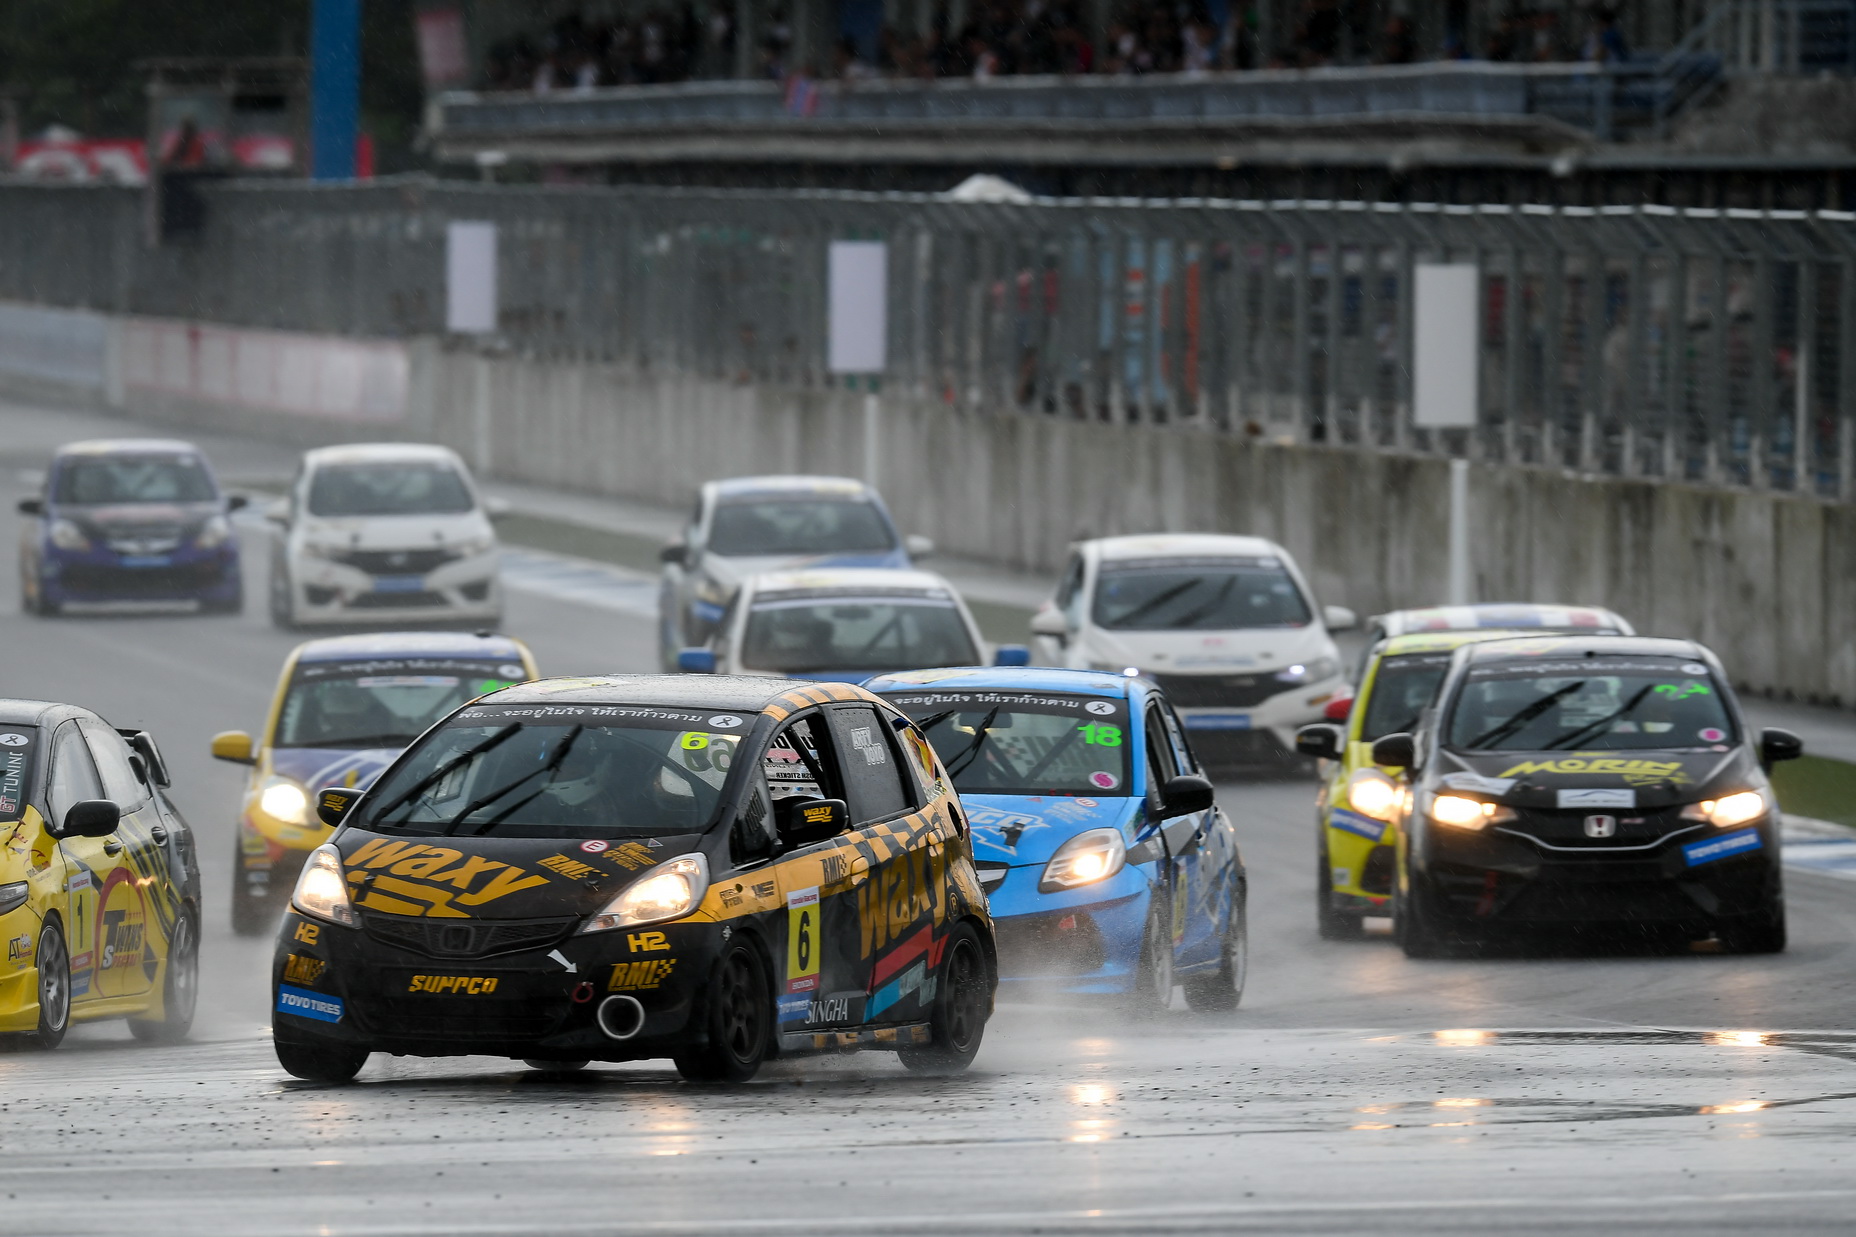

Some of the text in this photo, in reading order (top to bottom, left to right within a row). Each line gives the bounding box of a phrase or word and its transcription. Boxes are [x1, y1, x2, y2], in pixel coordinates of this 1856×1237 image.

[681, 732, 709, 750] 6
[1077, 725, 1122, 747] 18
[1497, 759, 1684, 779] MORIN
[803, 806, 832, 819] waxy
[345, 838, 551, 906] waxy
[858, 814, 946, 961] waxy
[77, 894, 83, 949] 1
[294, 922, 320, 946] H2
[627, 932, 671, 952] H2
[798, 911, 810, 971] 6
[281, 993, 341, 1015] TOYO TIRES
[804, 998, 849, 1024] SINGHA
